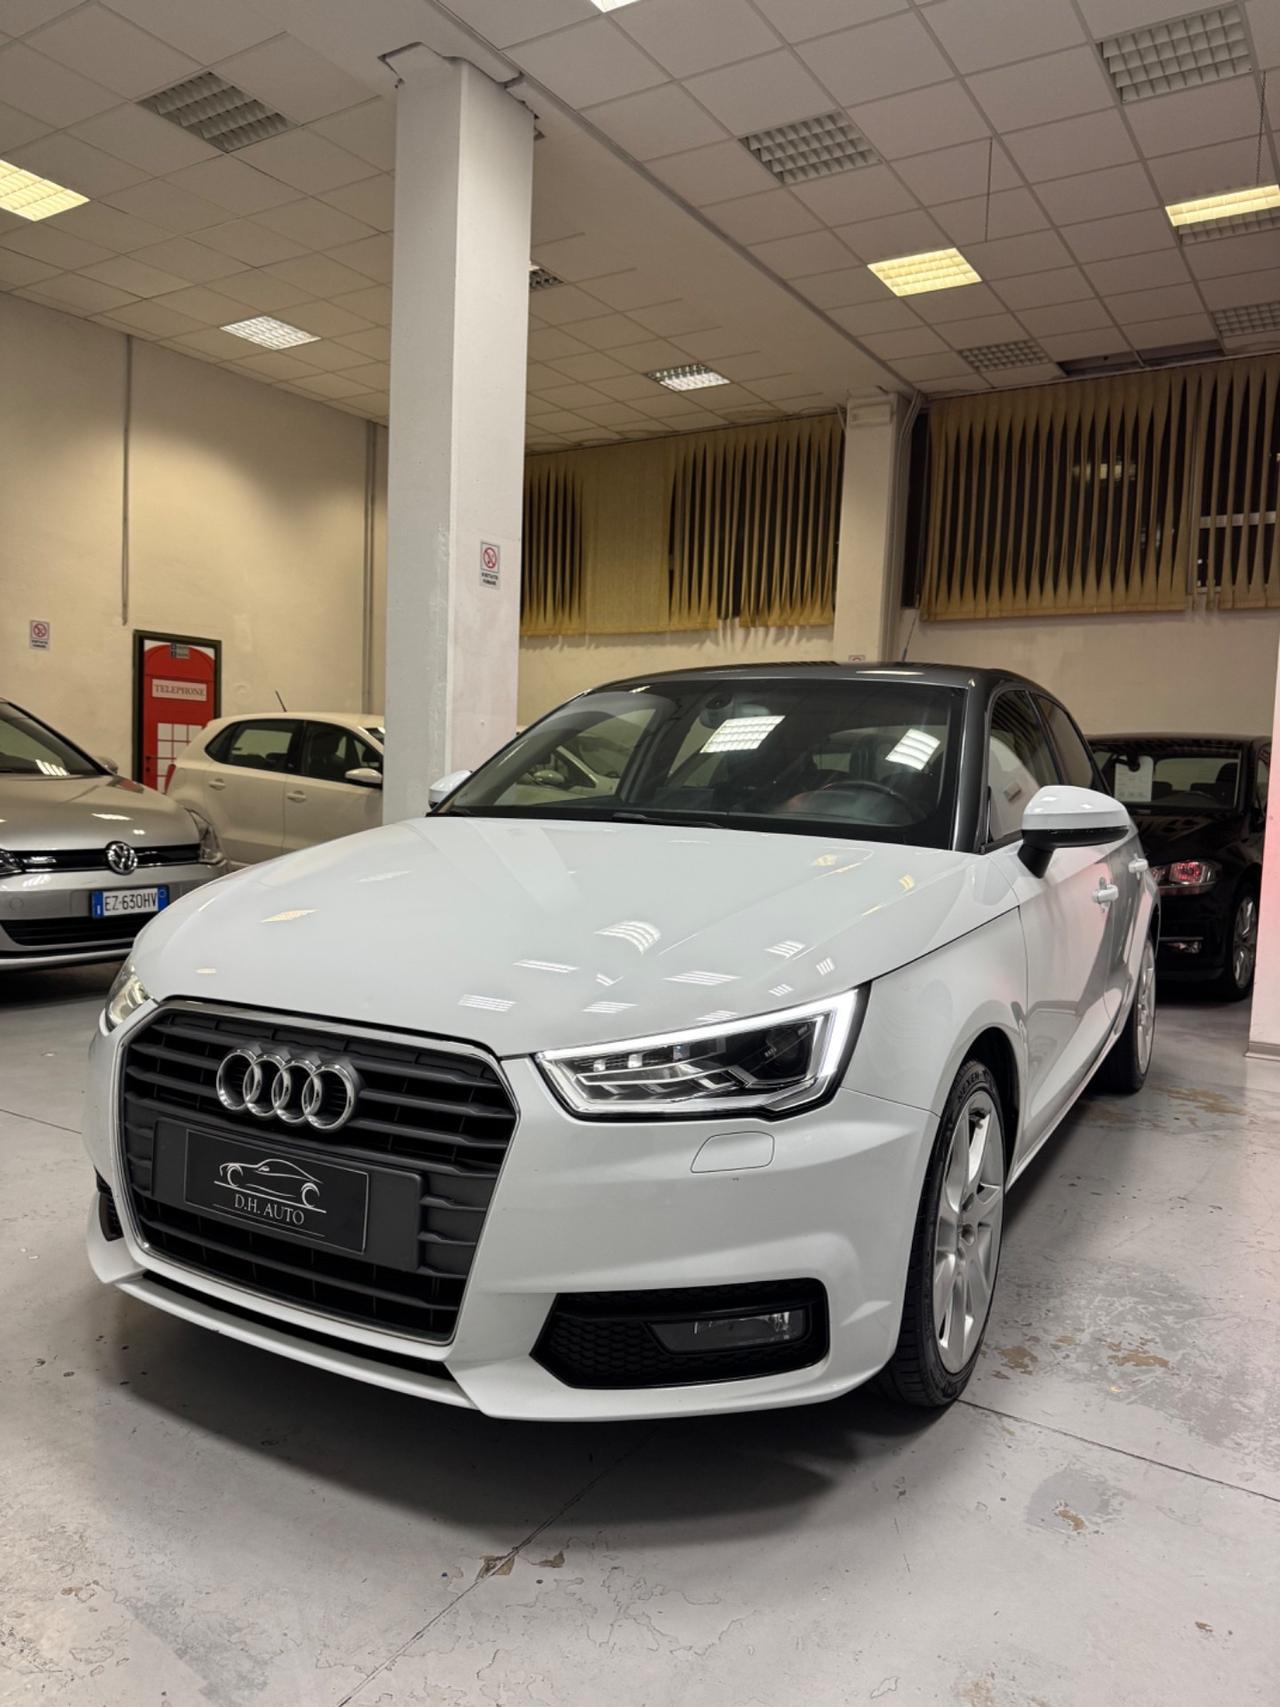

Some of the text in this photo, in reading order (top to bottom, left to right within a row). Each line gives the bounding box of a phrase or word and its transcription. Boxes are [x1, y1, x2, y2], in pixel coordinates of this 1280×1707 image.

[154, 684, 206, 697] TELEPHONE
[234, 1193, 305, 1226] D.H. AUTO
